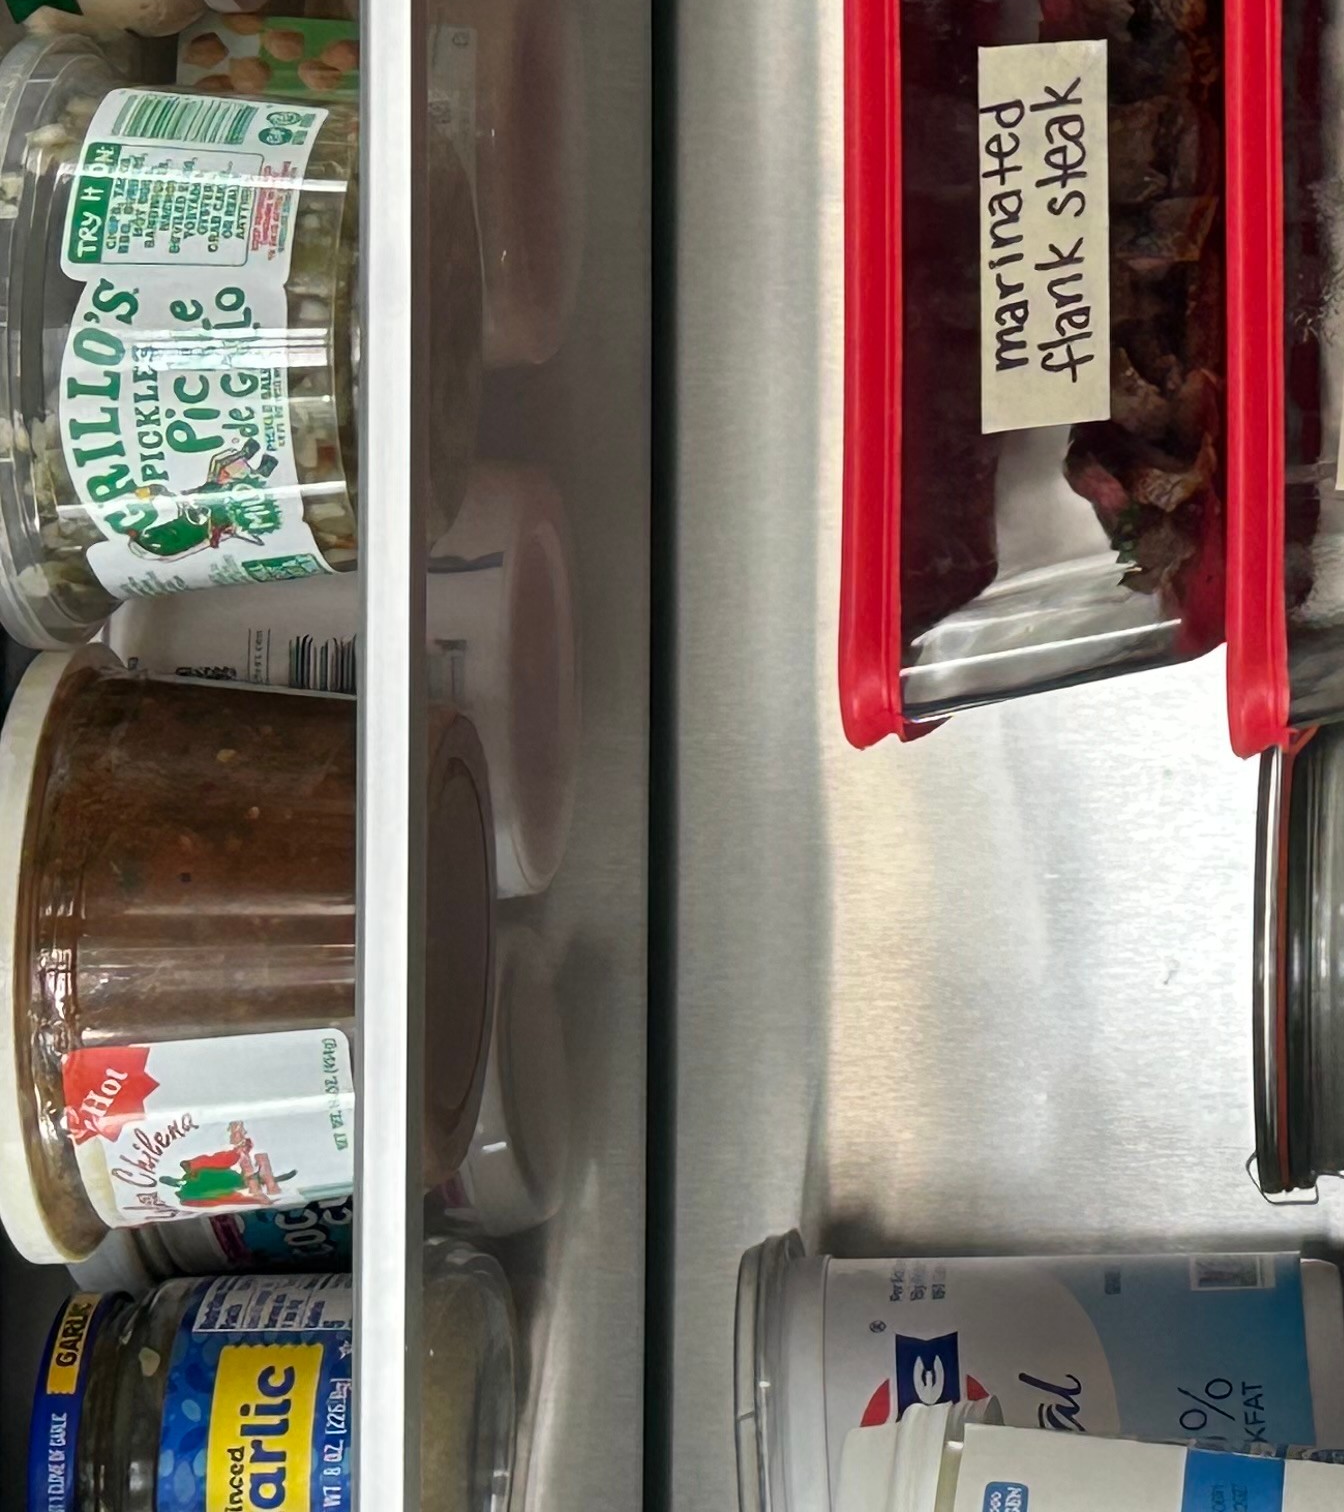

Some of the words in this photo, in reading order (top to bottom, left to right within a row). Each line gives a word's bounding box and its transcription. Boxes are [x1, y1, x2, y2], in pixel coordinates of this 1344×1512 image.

[1029, 76, 1088, 218] steak
[77, 211, 102, 257] TRY
[977, 98, 1030, 372] marinated
[164, 299, 223, 453] Pice
[1034, 236, 1096, 383] flank
[66, 278, 160, 536] GRILLO'S
[131, 345, 169, 481] PICKLES
[221, 406, 260, 438] de
[79, 1068, 128, 1117] Hot
[110, 1113, 200, 1188] Chilena
[55, 1302, 93, 1367] GARLIC
[240, 1364, 296, 1510] arlic
